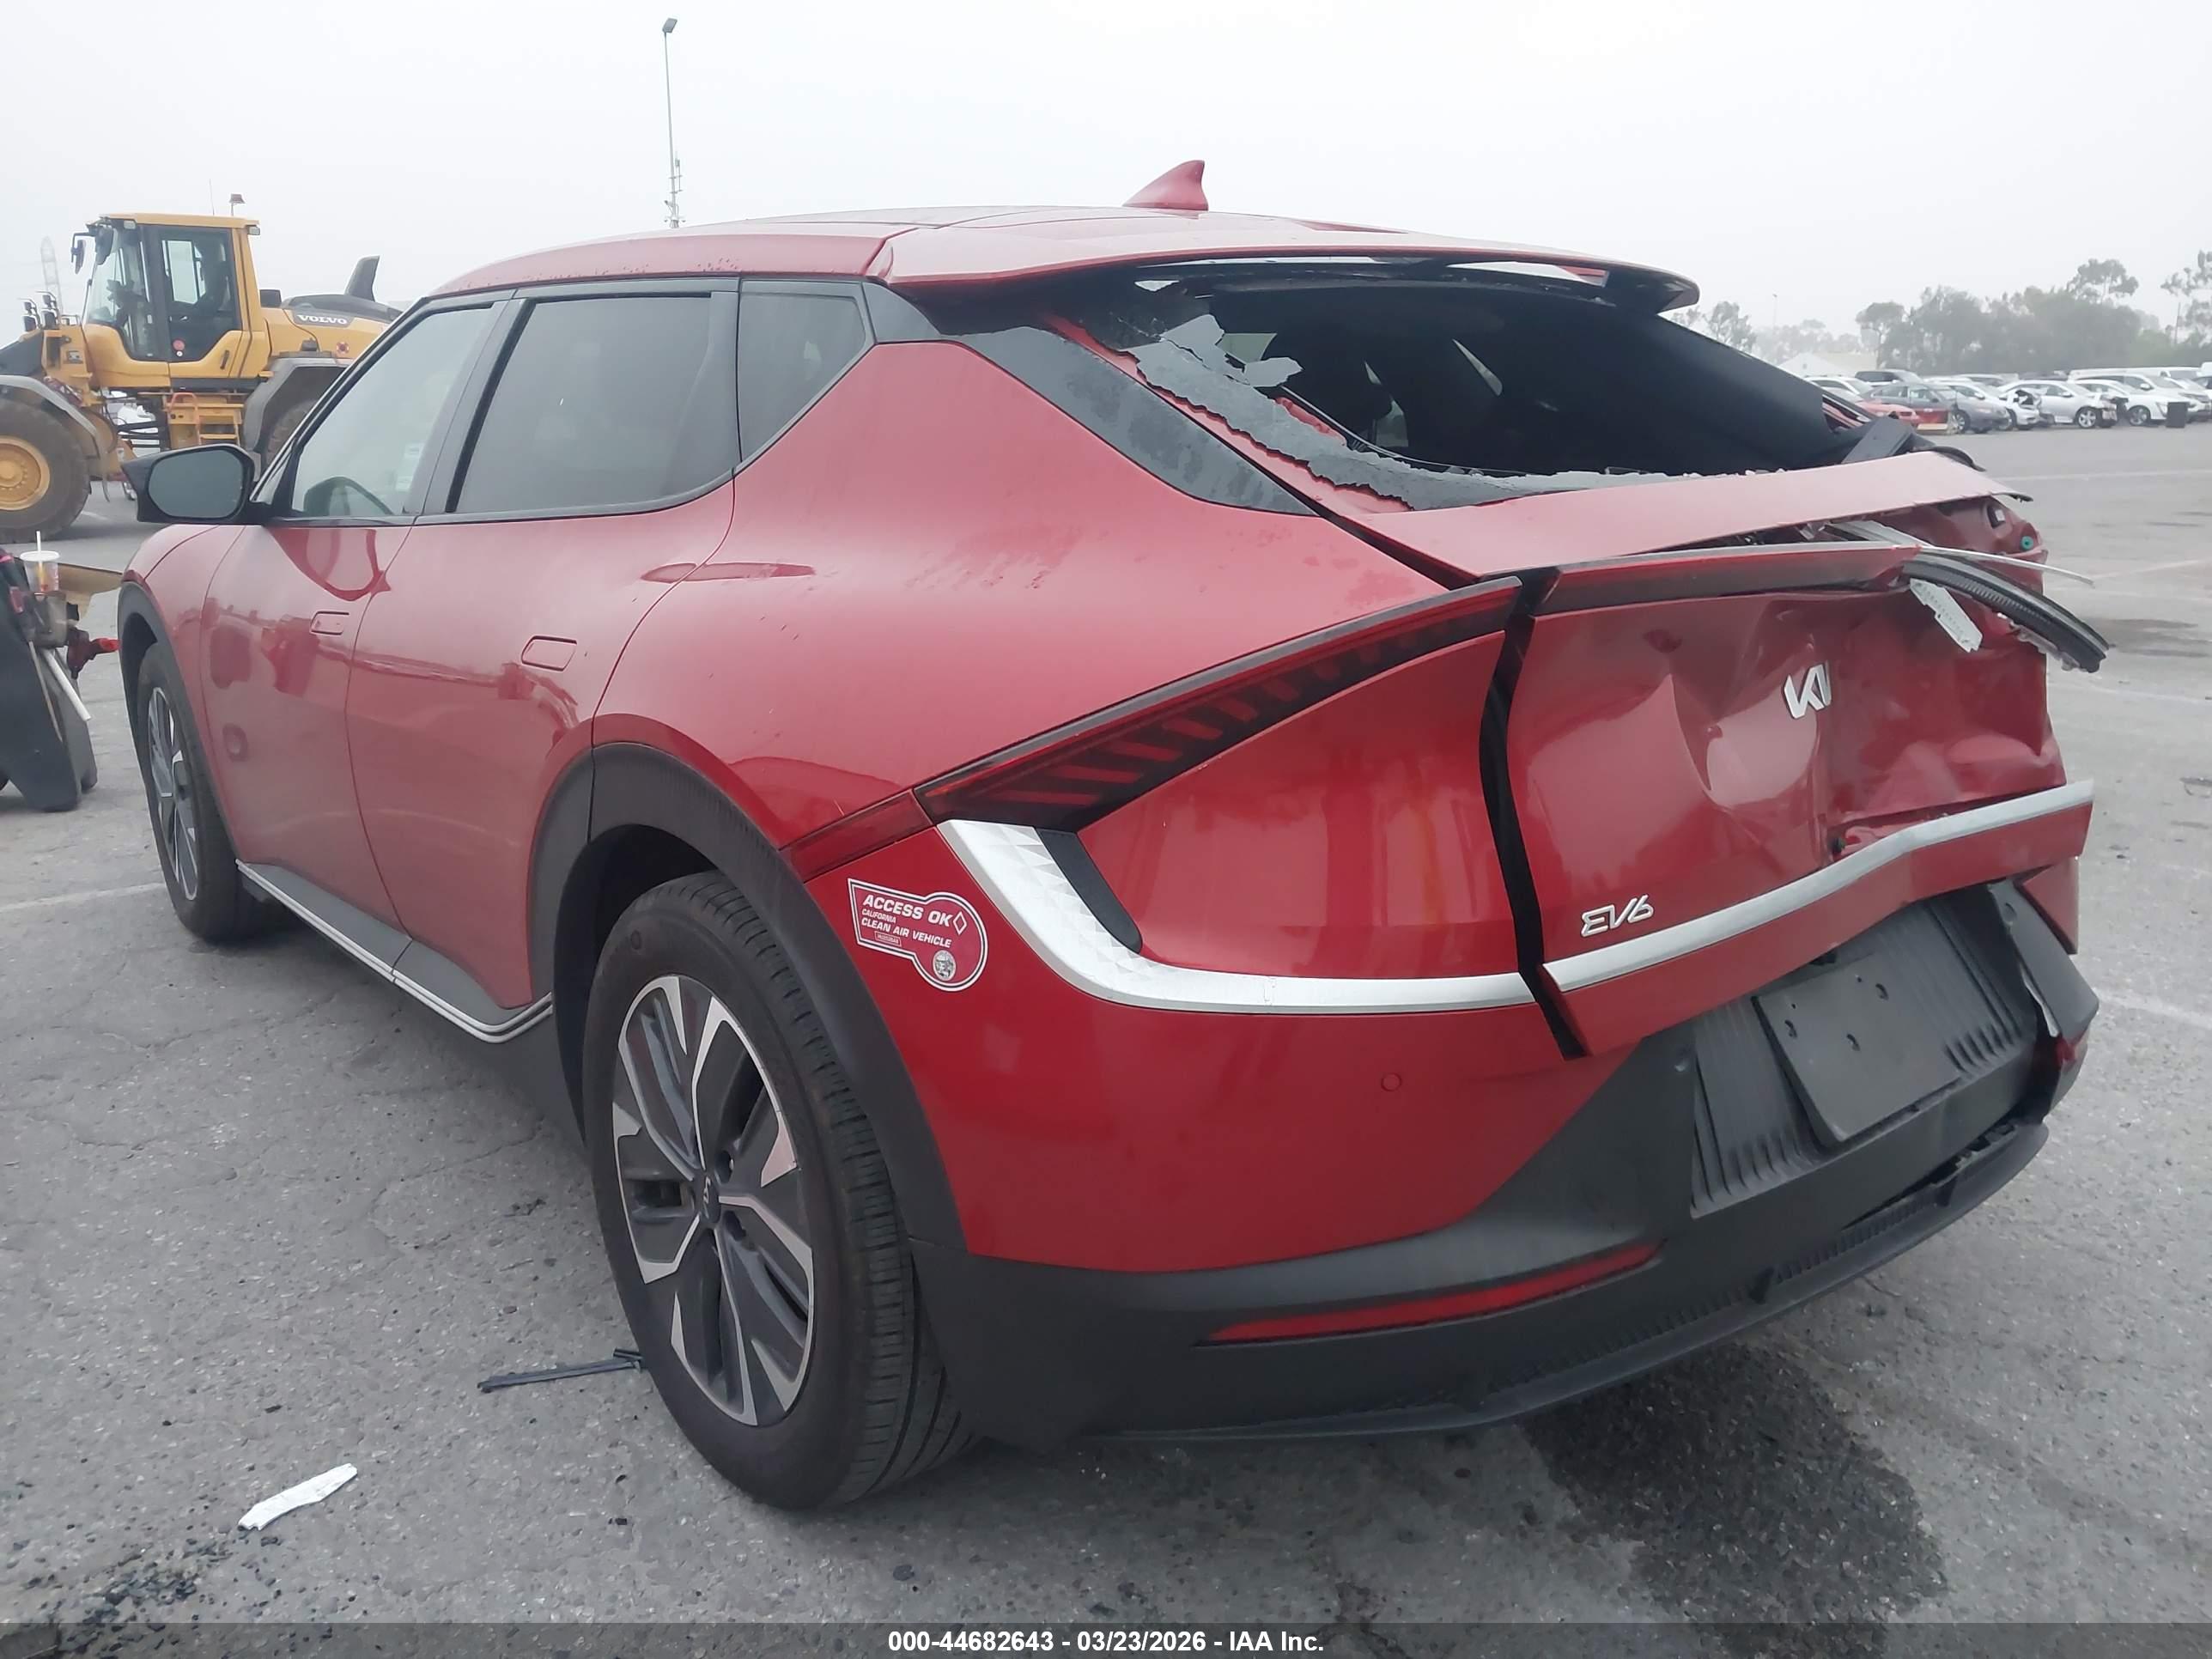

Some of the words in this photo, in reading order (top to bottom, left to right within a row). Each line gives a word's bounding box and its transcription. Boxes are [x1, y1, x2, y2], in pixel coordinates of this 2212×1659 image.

[297, 314, 347, 325] VOLVO
[861, 908, 896, 925] CALIFORNIA
[863, 894, 924, 920] ACCESS
[927, 911, 953, 927] OK
[1581, 895, 1654, 937] EV6
[861, 917, 891, 933] CLEAN
[894, 926, 910, 937] AIR
[912, 931, 951, 948] VEHICLE
